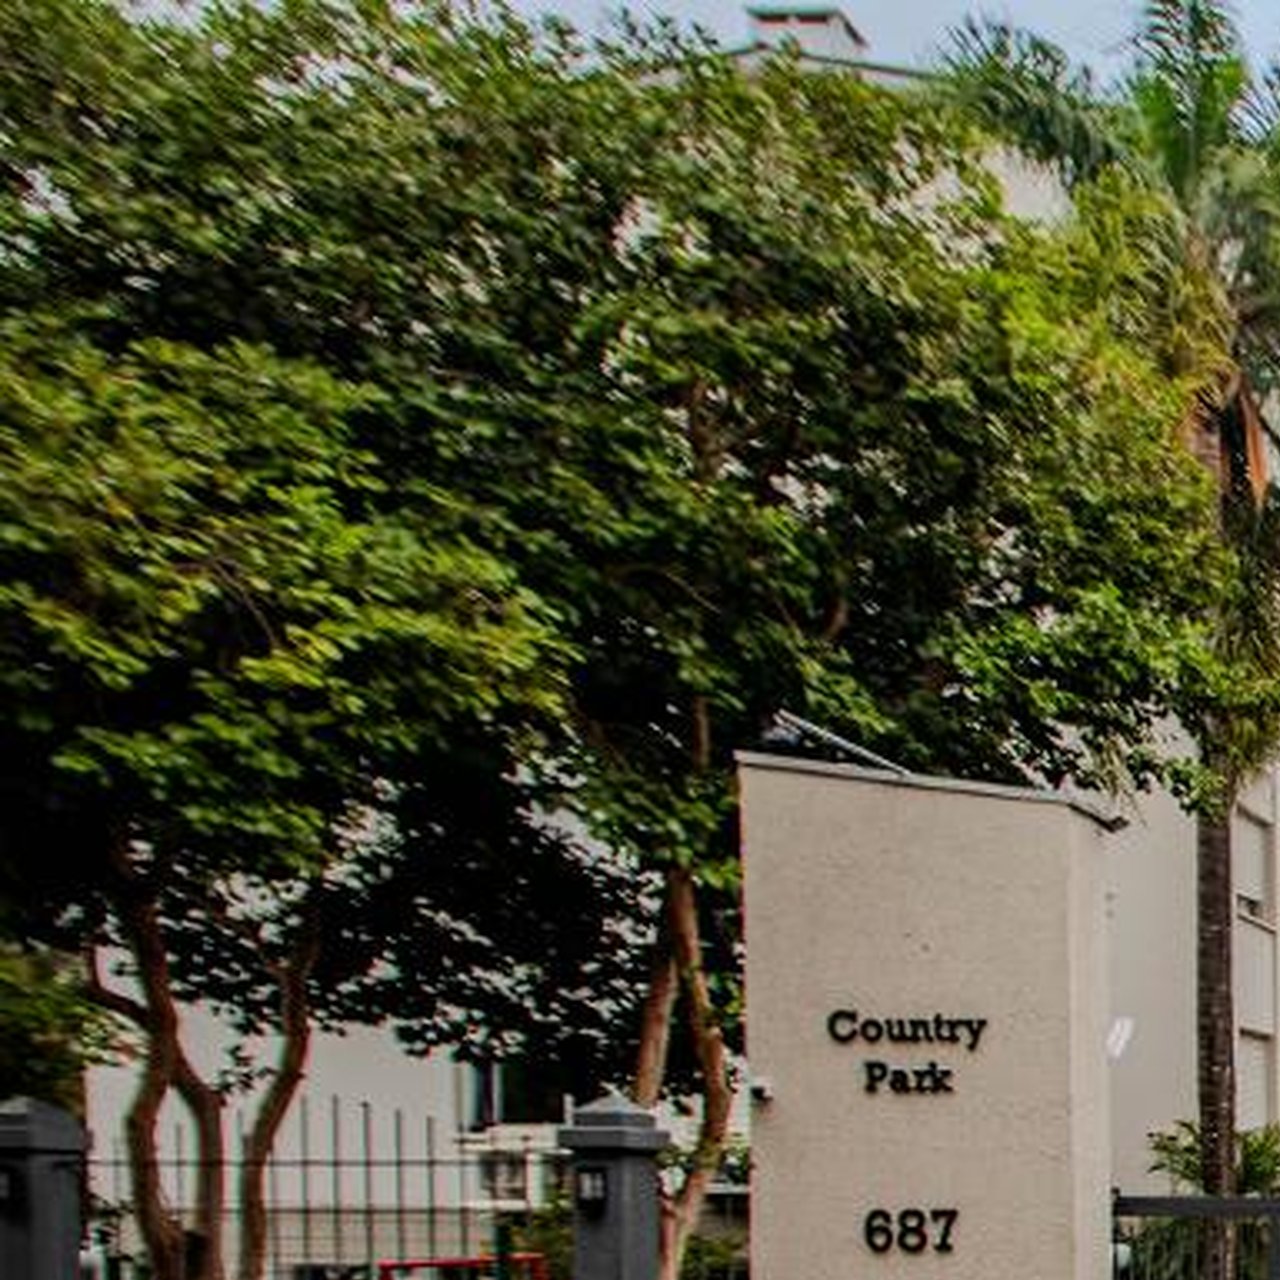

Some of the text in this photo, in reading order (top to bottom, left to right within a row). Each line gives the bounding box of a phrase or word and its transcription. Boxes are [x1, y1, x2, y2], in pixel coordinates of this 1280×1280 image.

[827, 1010, 987, 1050] Country
[864, 1062, 953, 1093] Park
[864, 1210, 957, 1252] 687
